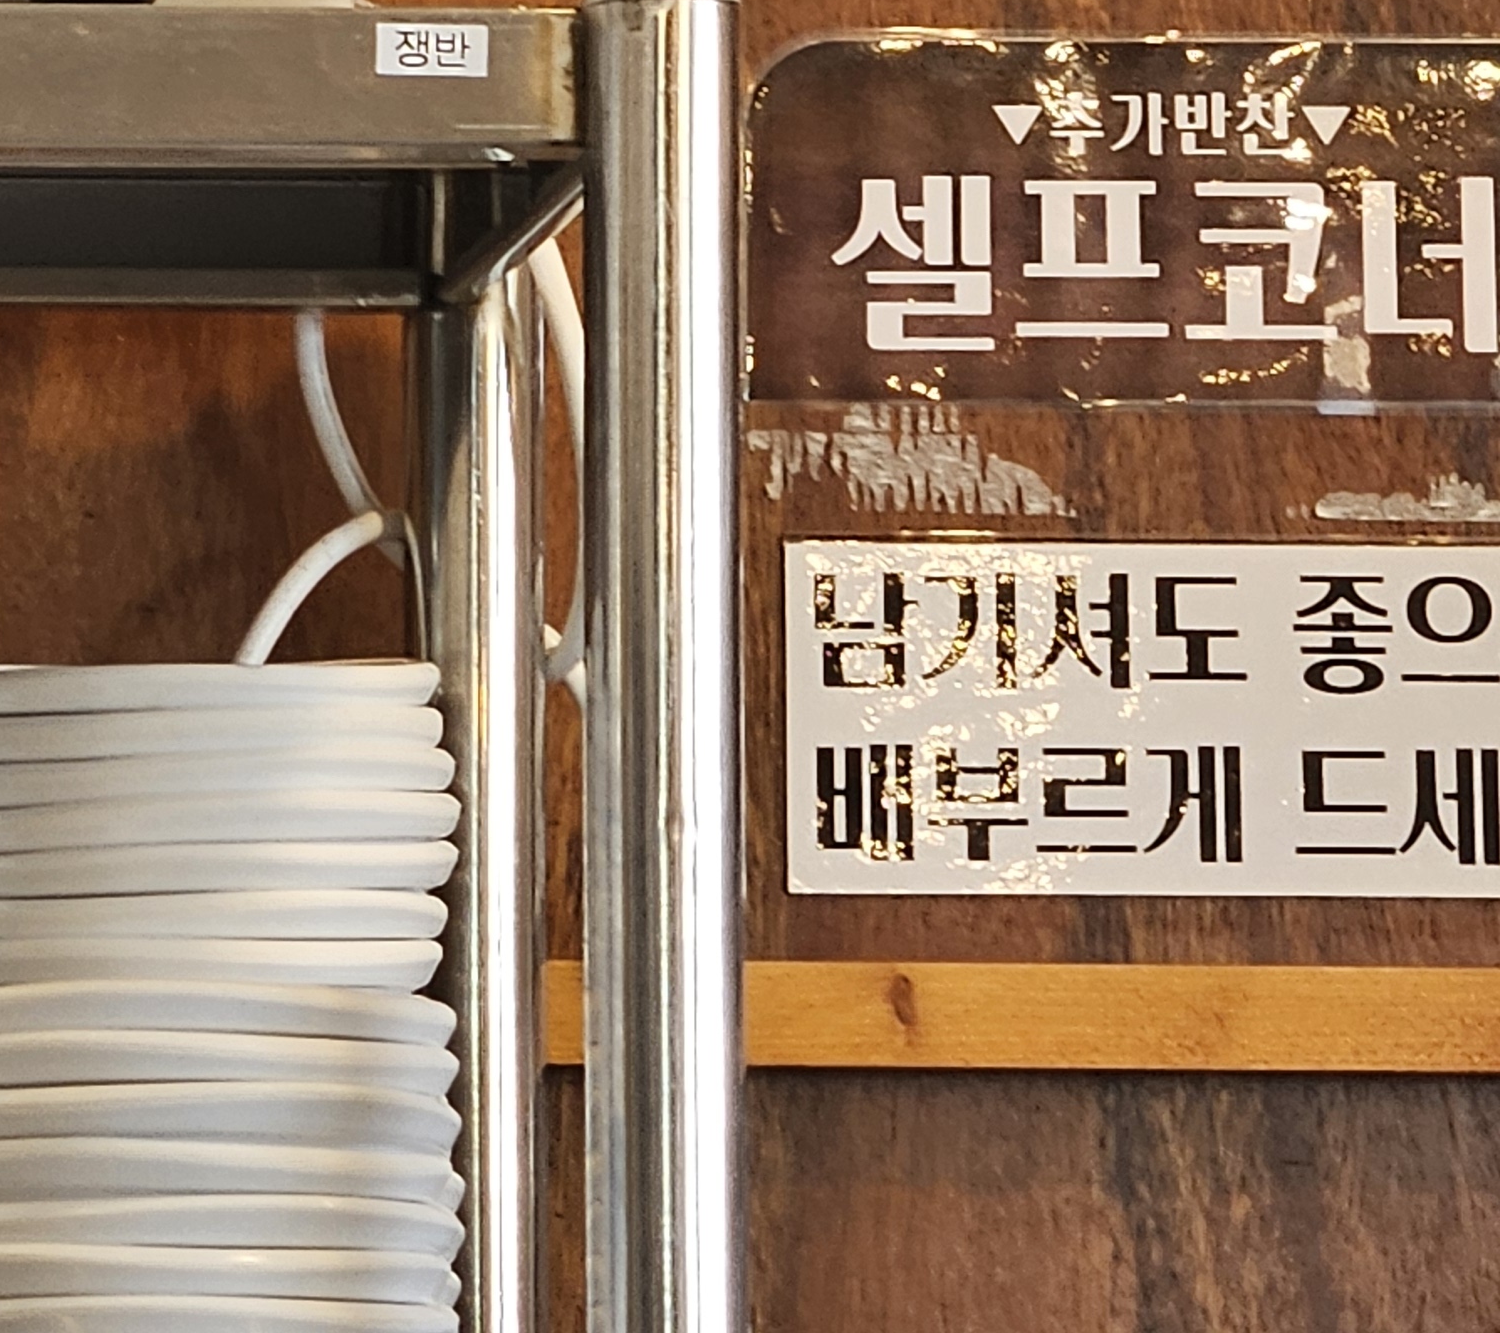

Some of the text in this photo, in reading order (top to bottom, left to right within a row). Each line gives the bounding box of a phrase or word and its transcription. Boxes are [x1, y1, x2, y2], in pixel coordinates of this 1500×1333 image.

[394, 30, 471, 68] 쟁반
[1049, 91, 1297, 157] 추가반찬
[831, 175, 1499, 352] 셀프코너
[814, 572, 1500, 695] 남기셔도 좋으
[815, 744, 1500, 866] 배부르게 드세
